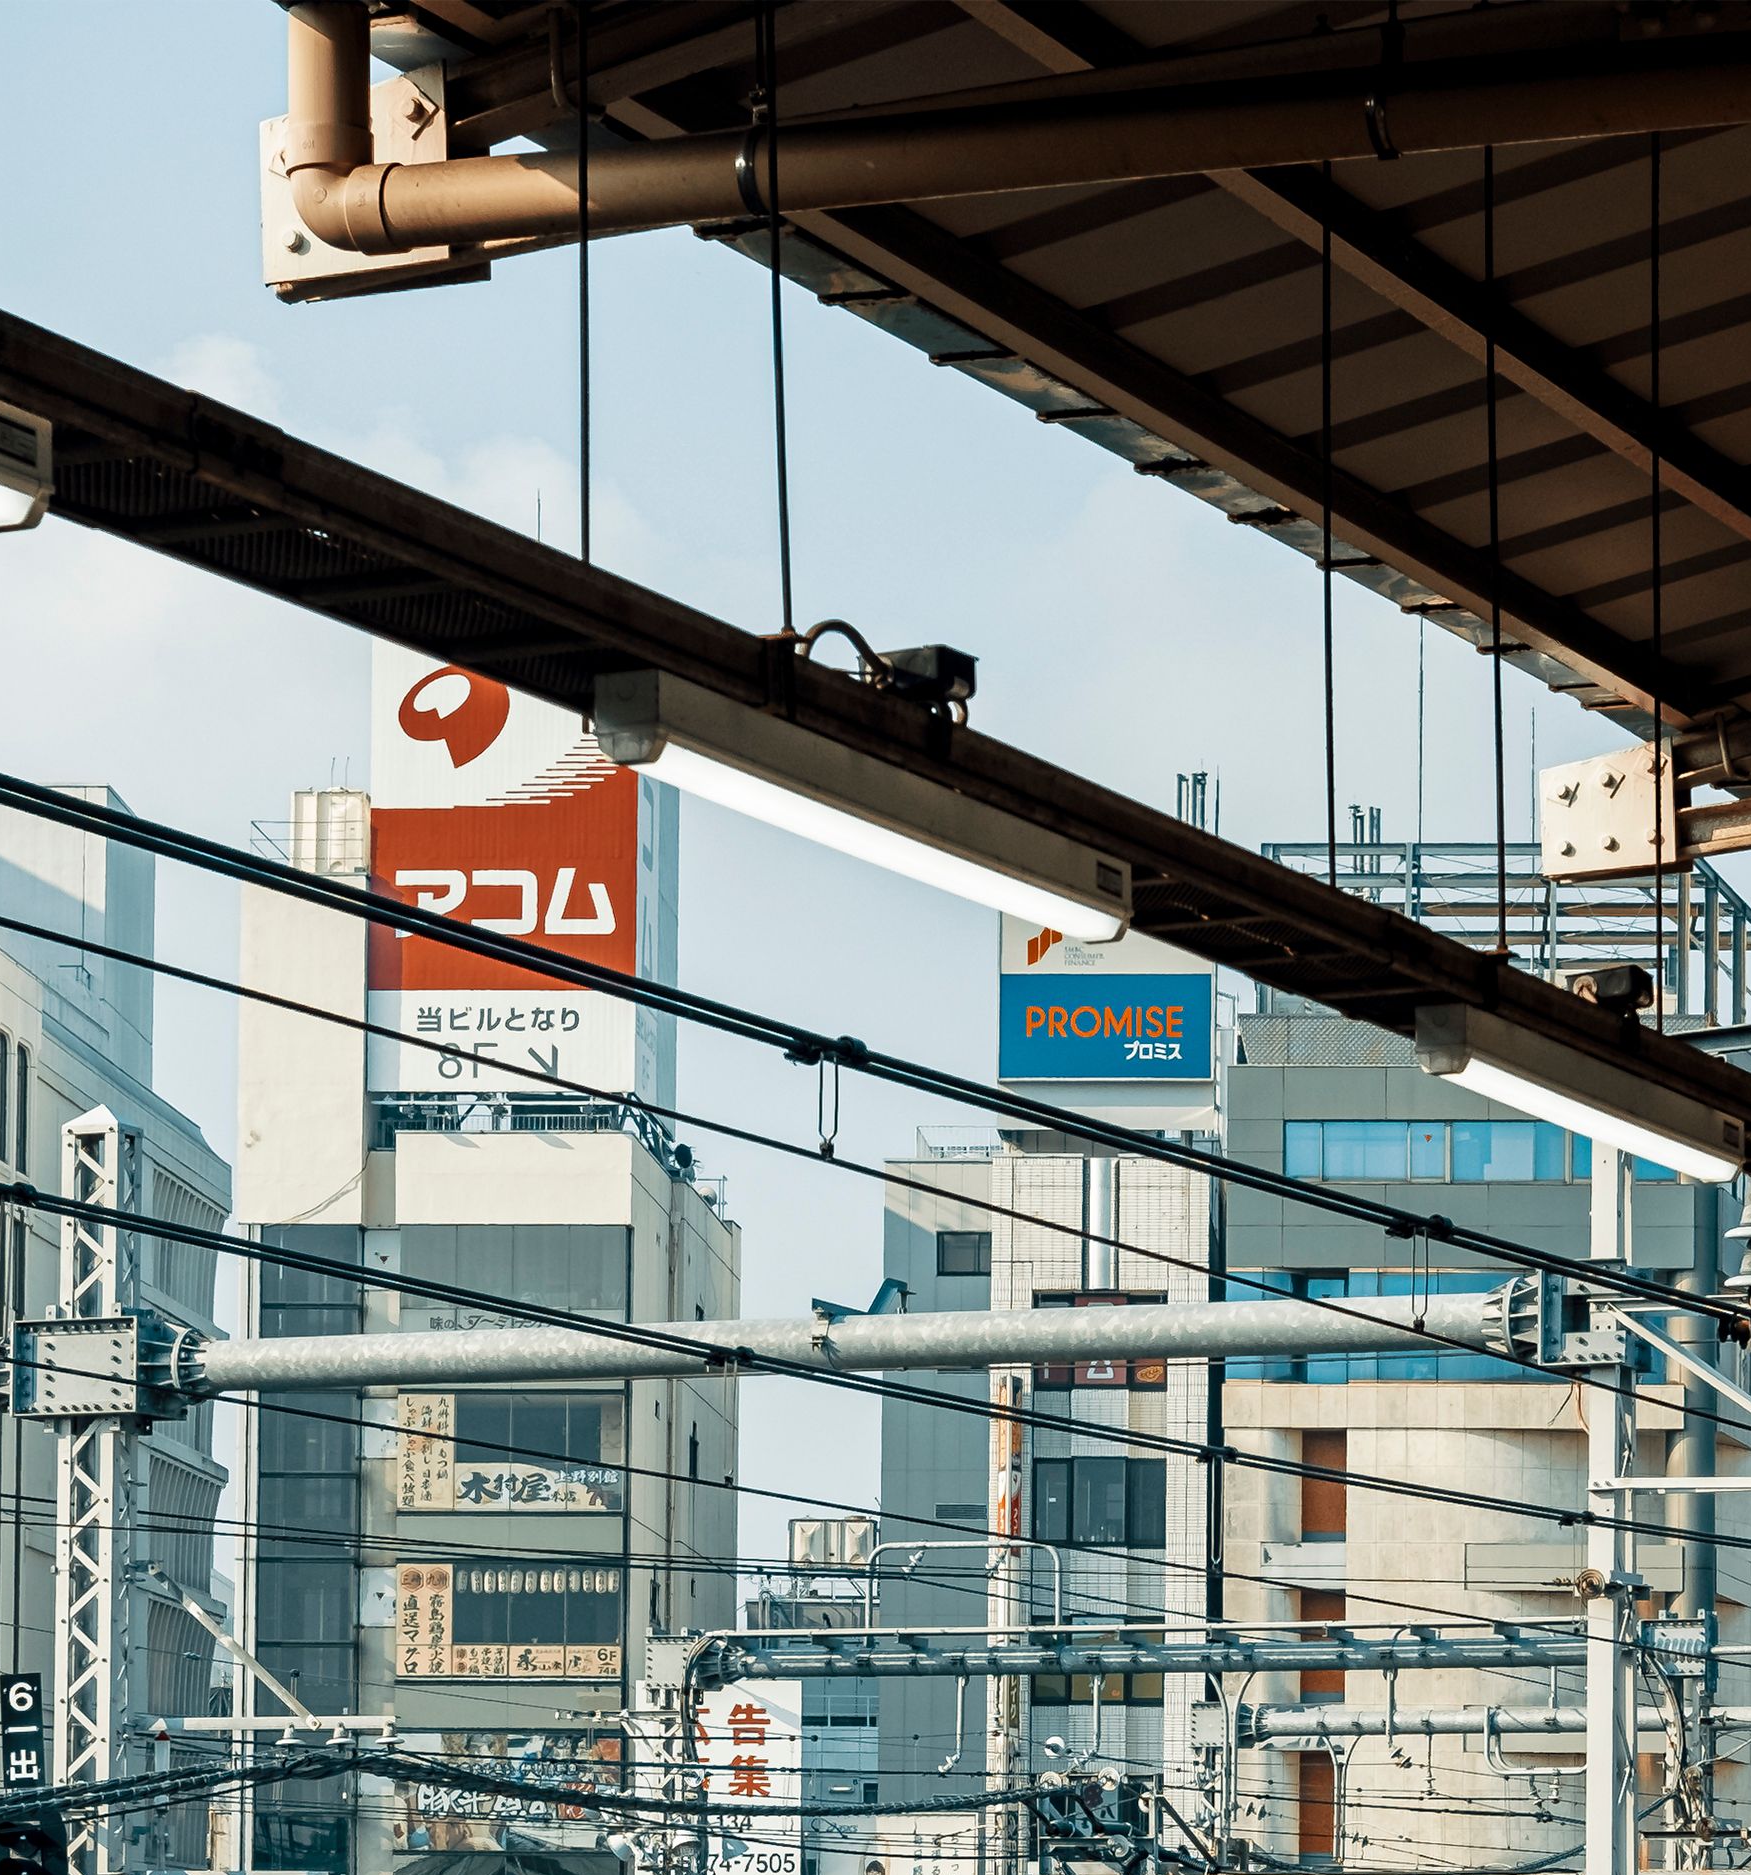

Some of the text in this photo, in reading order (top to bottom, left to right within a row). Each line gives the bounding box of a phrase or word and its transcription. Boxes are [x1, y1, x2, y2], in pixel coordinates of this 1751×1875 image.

[393, 867, 617, 940] アコム
[417, 1006, 582, 1033] 当ビルとなり
[1026, 1006, 1184, 1038] PROMISE
[1123, 1040, 1183, 1060] プロミス
[456, 1472, 551, 1504] 木村屋
[597, 1648, 617, 1662] 6F
